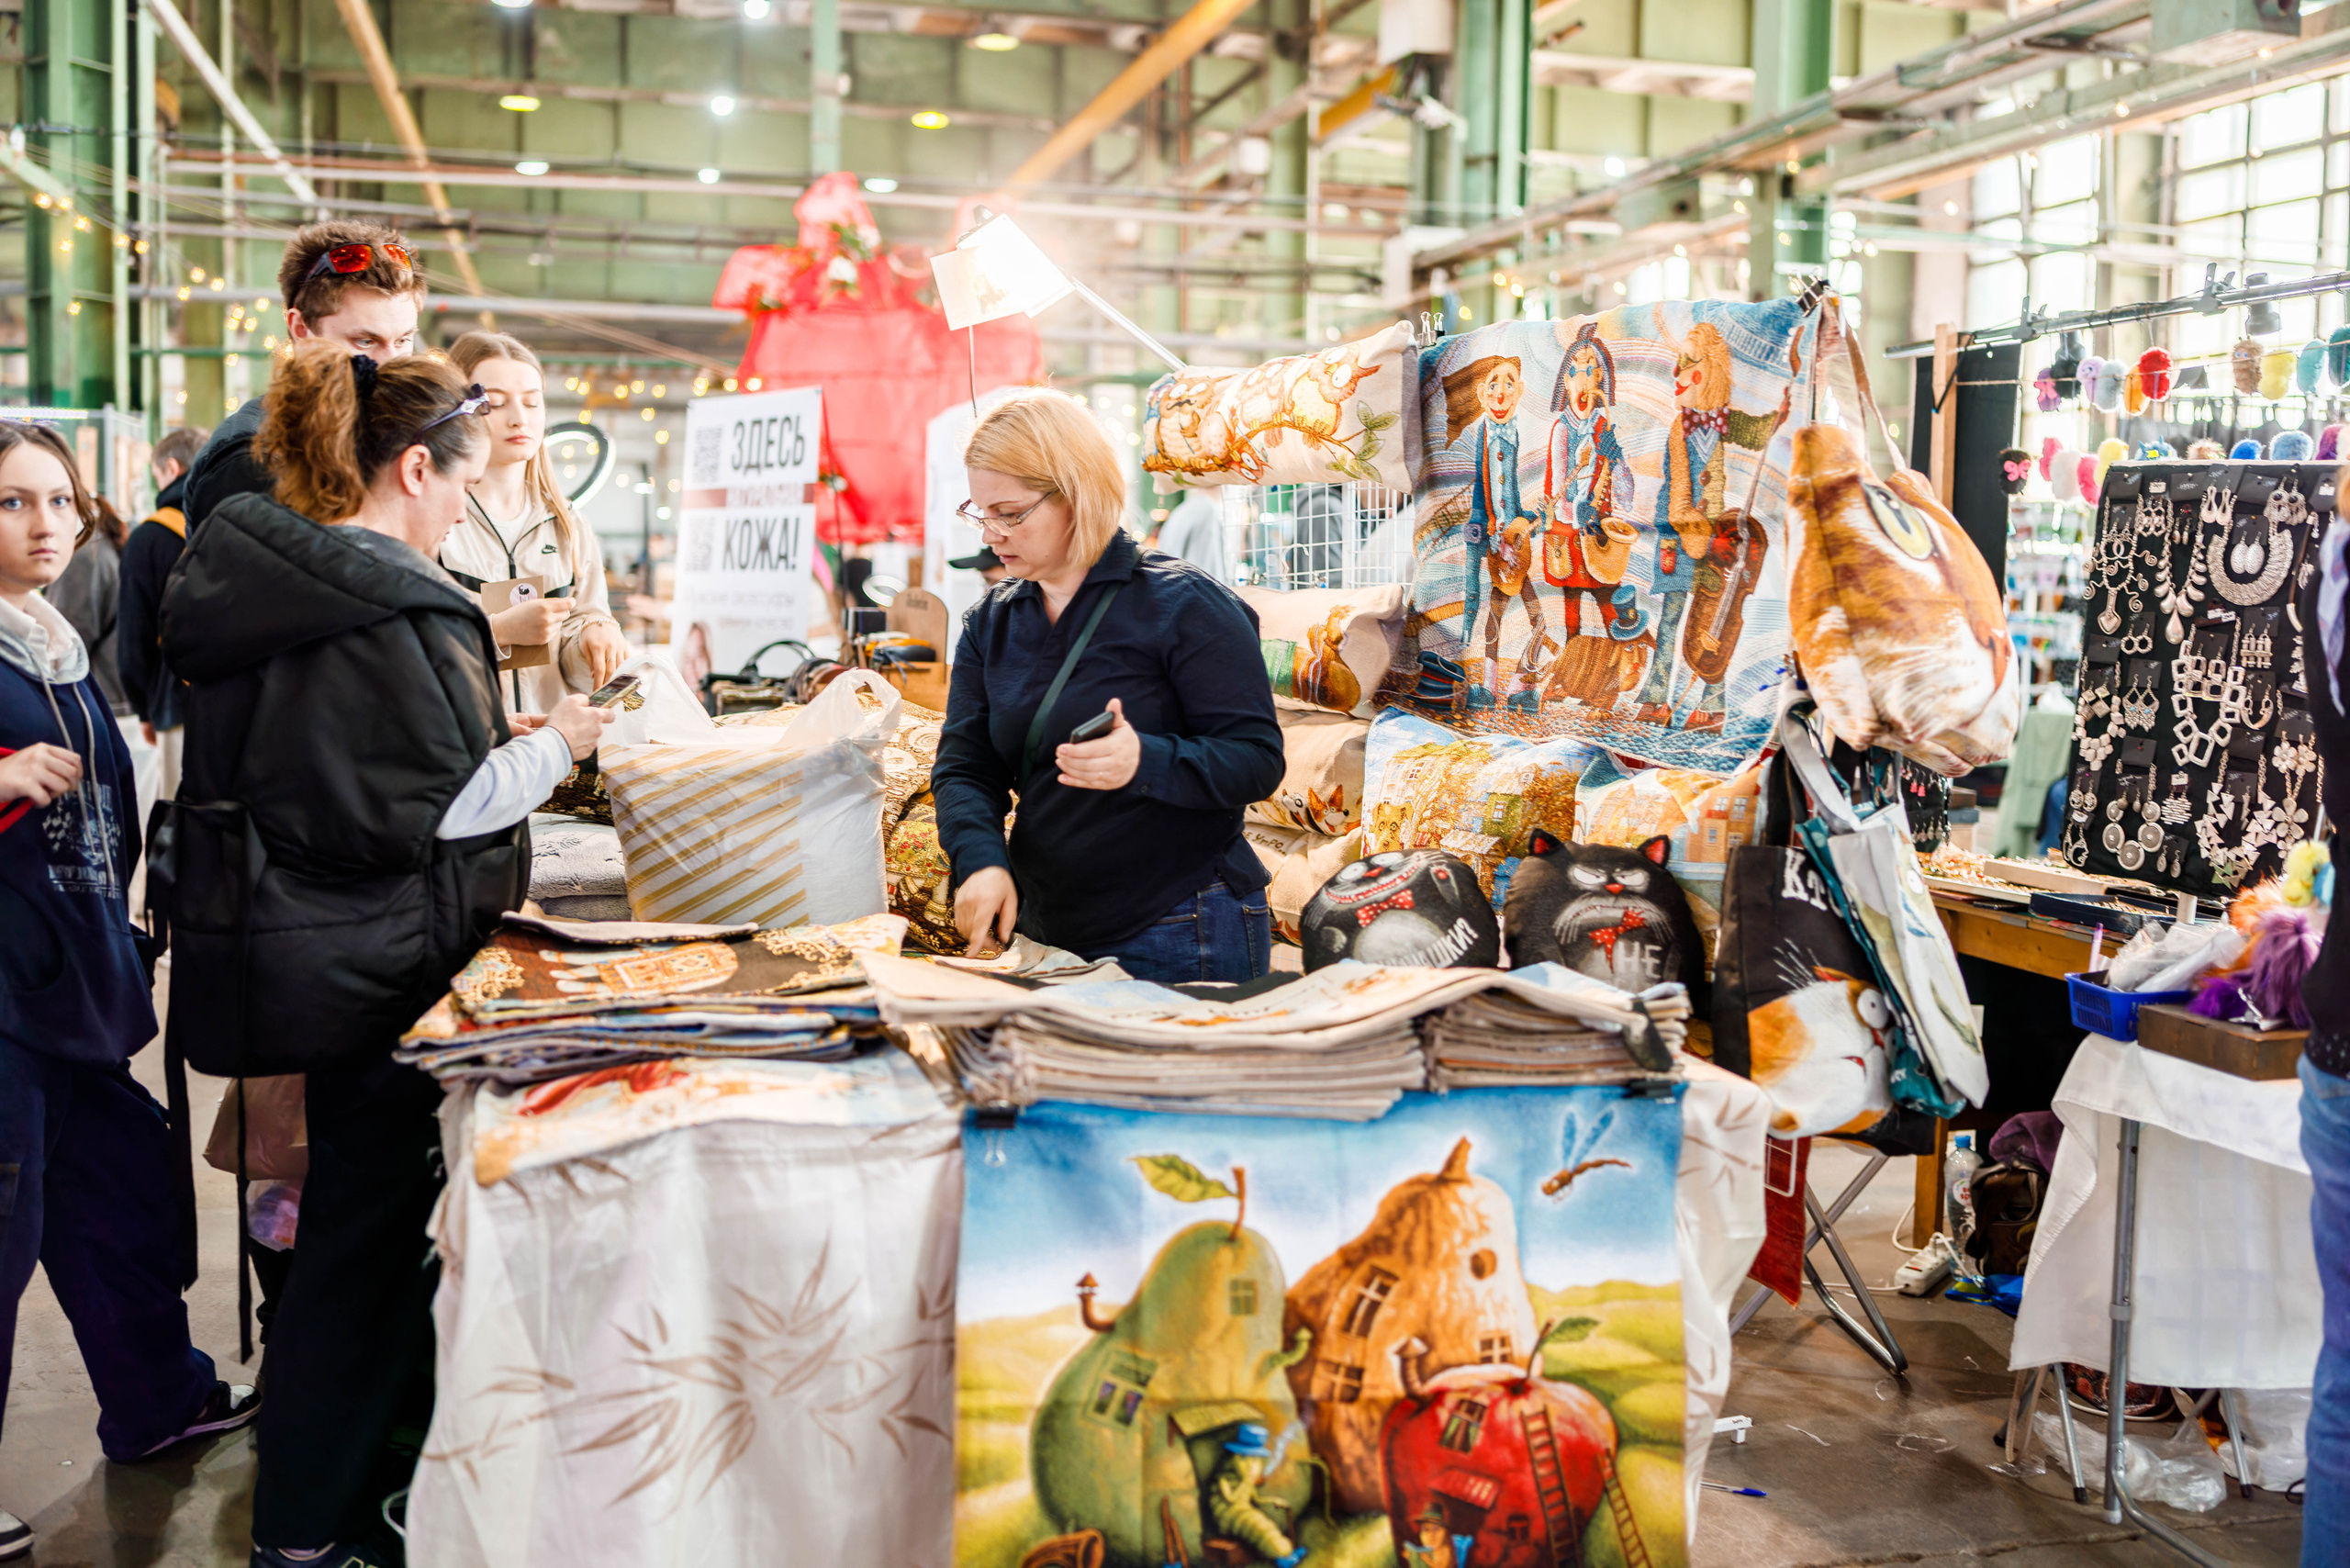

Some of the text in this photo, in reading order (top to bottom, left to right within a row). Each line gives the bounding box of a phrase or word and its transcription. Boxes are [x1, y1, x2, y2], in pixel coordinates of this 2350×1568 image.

[732, 415, 805, 475] ЗДЕСЬ
[722, 517, 800, 571] КОЖА!
[1617, 941, 1662, 980] НЕ
